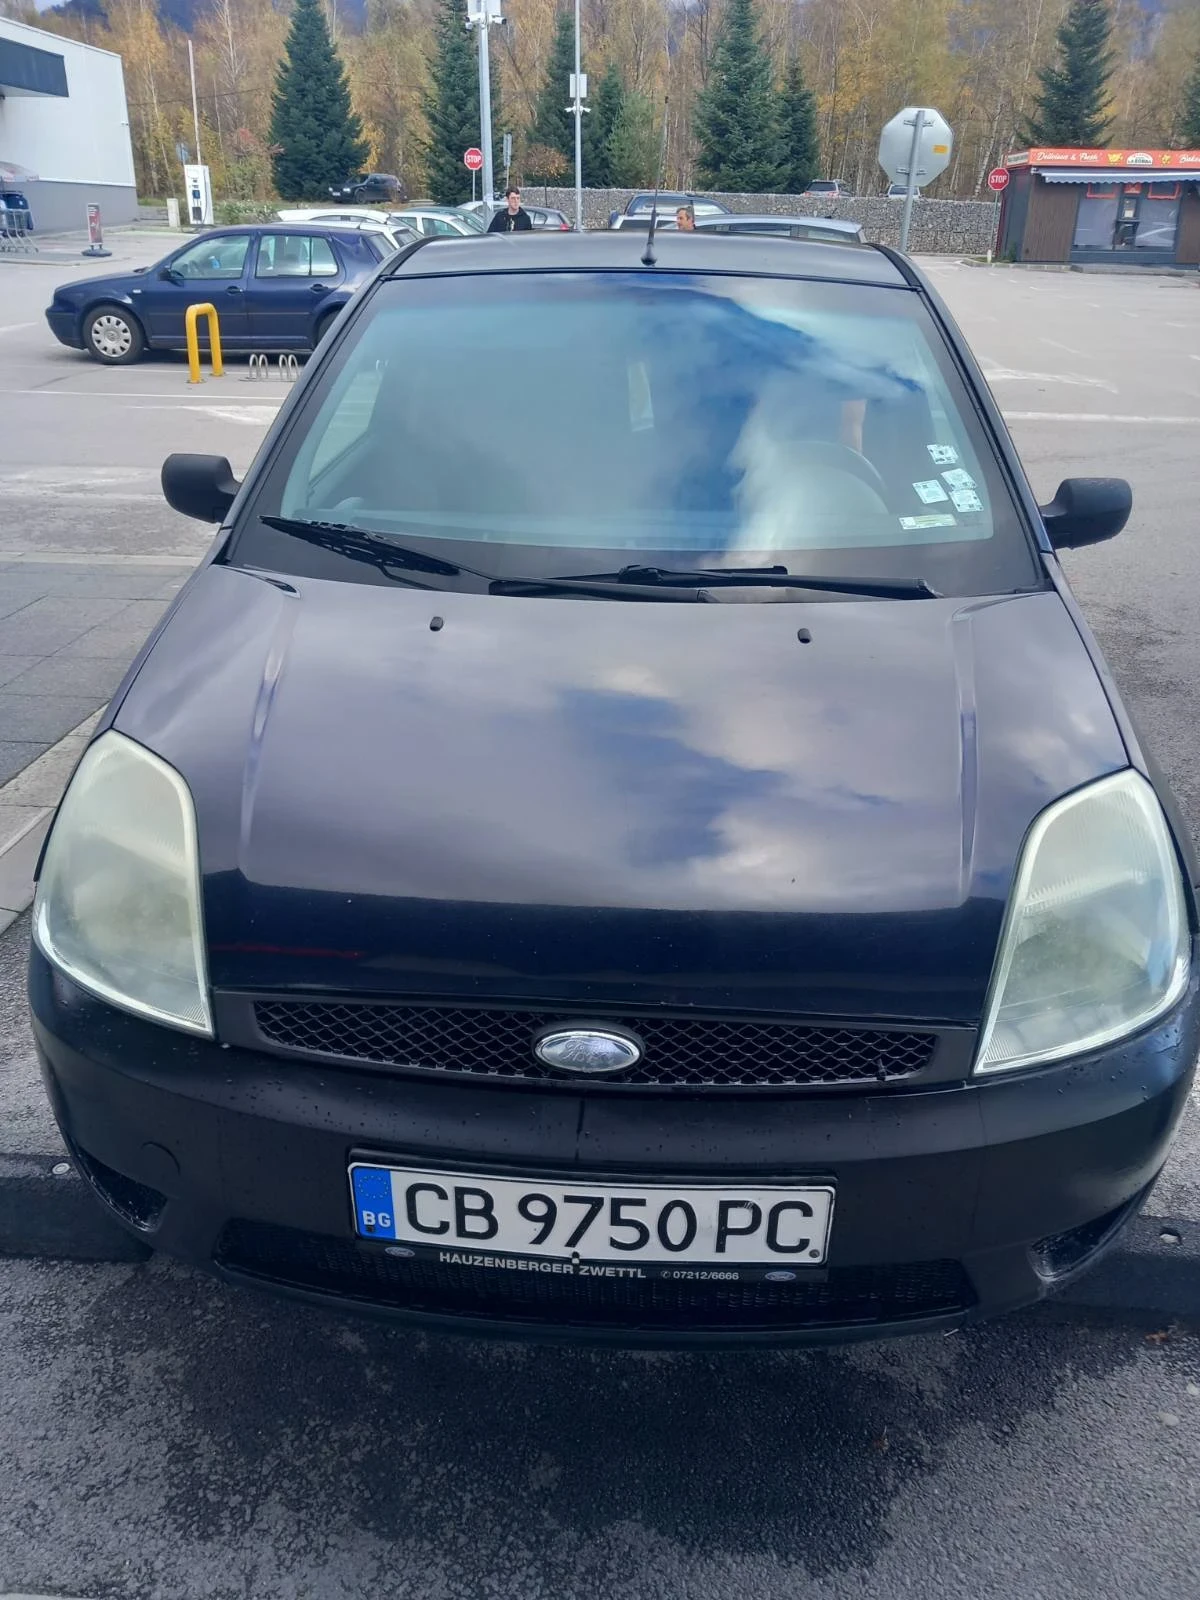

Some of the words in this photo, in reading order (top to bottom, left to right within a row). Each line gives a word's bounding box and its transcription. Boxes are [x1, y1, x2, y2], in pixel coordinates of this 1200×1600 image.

[466, 155, 482, 163] STOP
[990, 175, 1007, 184] STOP
[362, 1210, 391, 1228] BG
[405, 1182, 499, 1240] CB
[517, 1192, 697, 1252] 9750
[715, 1199, 813, 1255] PC
[439, 1252, 574, 1275] HAUZENBERGER
[579, 1265, 647, 1279] ZWETTL
[673, 1270, 739, 1280] 07212/6666
